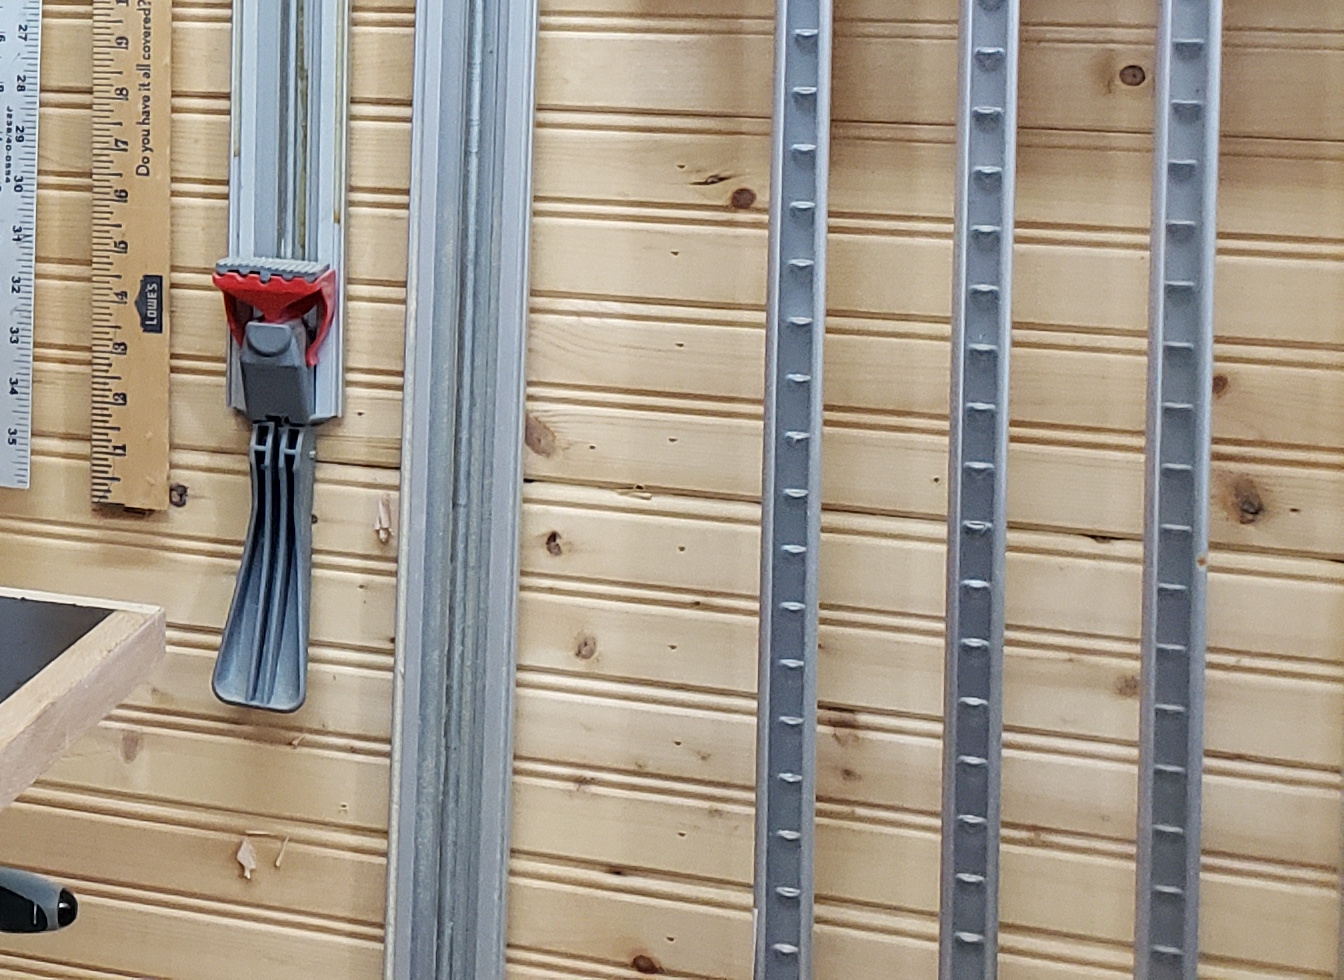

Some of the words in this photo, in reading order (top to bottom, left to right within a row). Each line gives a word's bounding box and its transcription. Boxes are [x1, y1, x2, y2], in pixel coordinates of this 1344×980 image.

[18, 25, 28, 41] 27
[115, 36, 129, 50] 9
[136, 64, 151, 79] all
[17, 75, 26, 92] 28
[139, 82, 151, 92] it
[115, 87, 129, 101] 8
[136, 95, 151, 126] have
[15, 125, 25, 142] 29
[142, 129, 154, 153] you
[114, 138, 128, 152] 7
[136, 156, 150, 177] Do
[14, 175, 23, 193] 30
[114, 189, 128, 203] 6
[113, 240, 128, 254] 5
[11, 276, 21, 294] 32
[112, 291, 128, 304] 4
[9, 327, 20, 344] 33
[112, 342, 128, 355] 3
[9, 377, 19, 395] 34
[112, 392, 127, 406] 2
[7, 428, 18, 446] 35
[112, 444, 126, 456] 1
